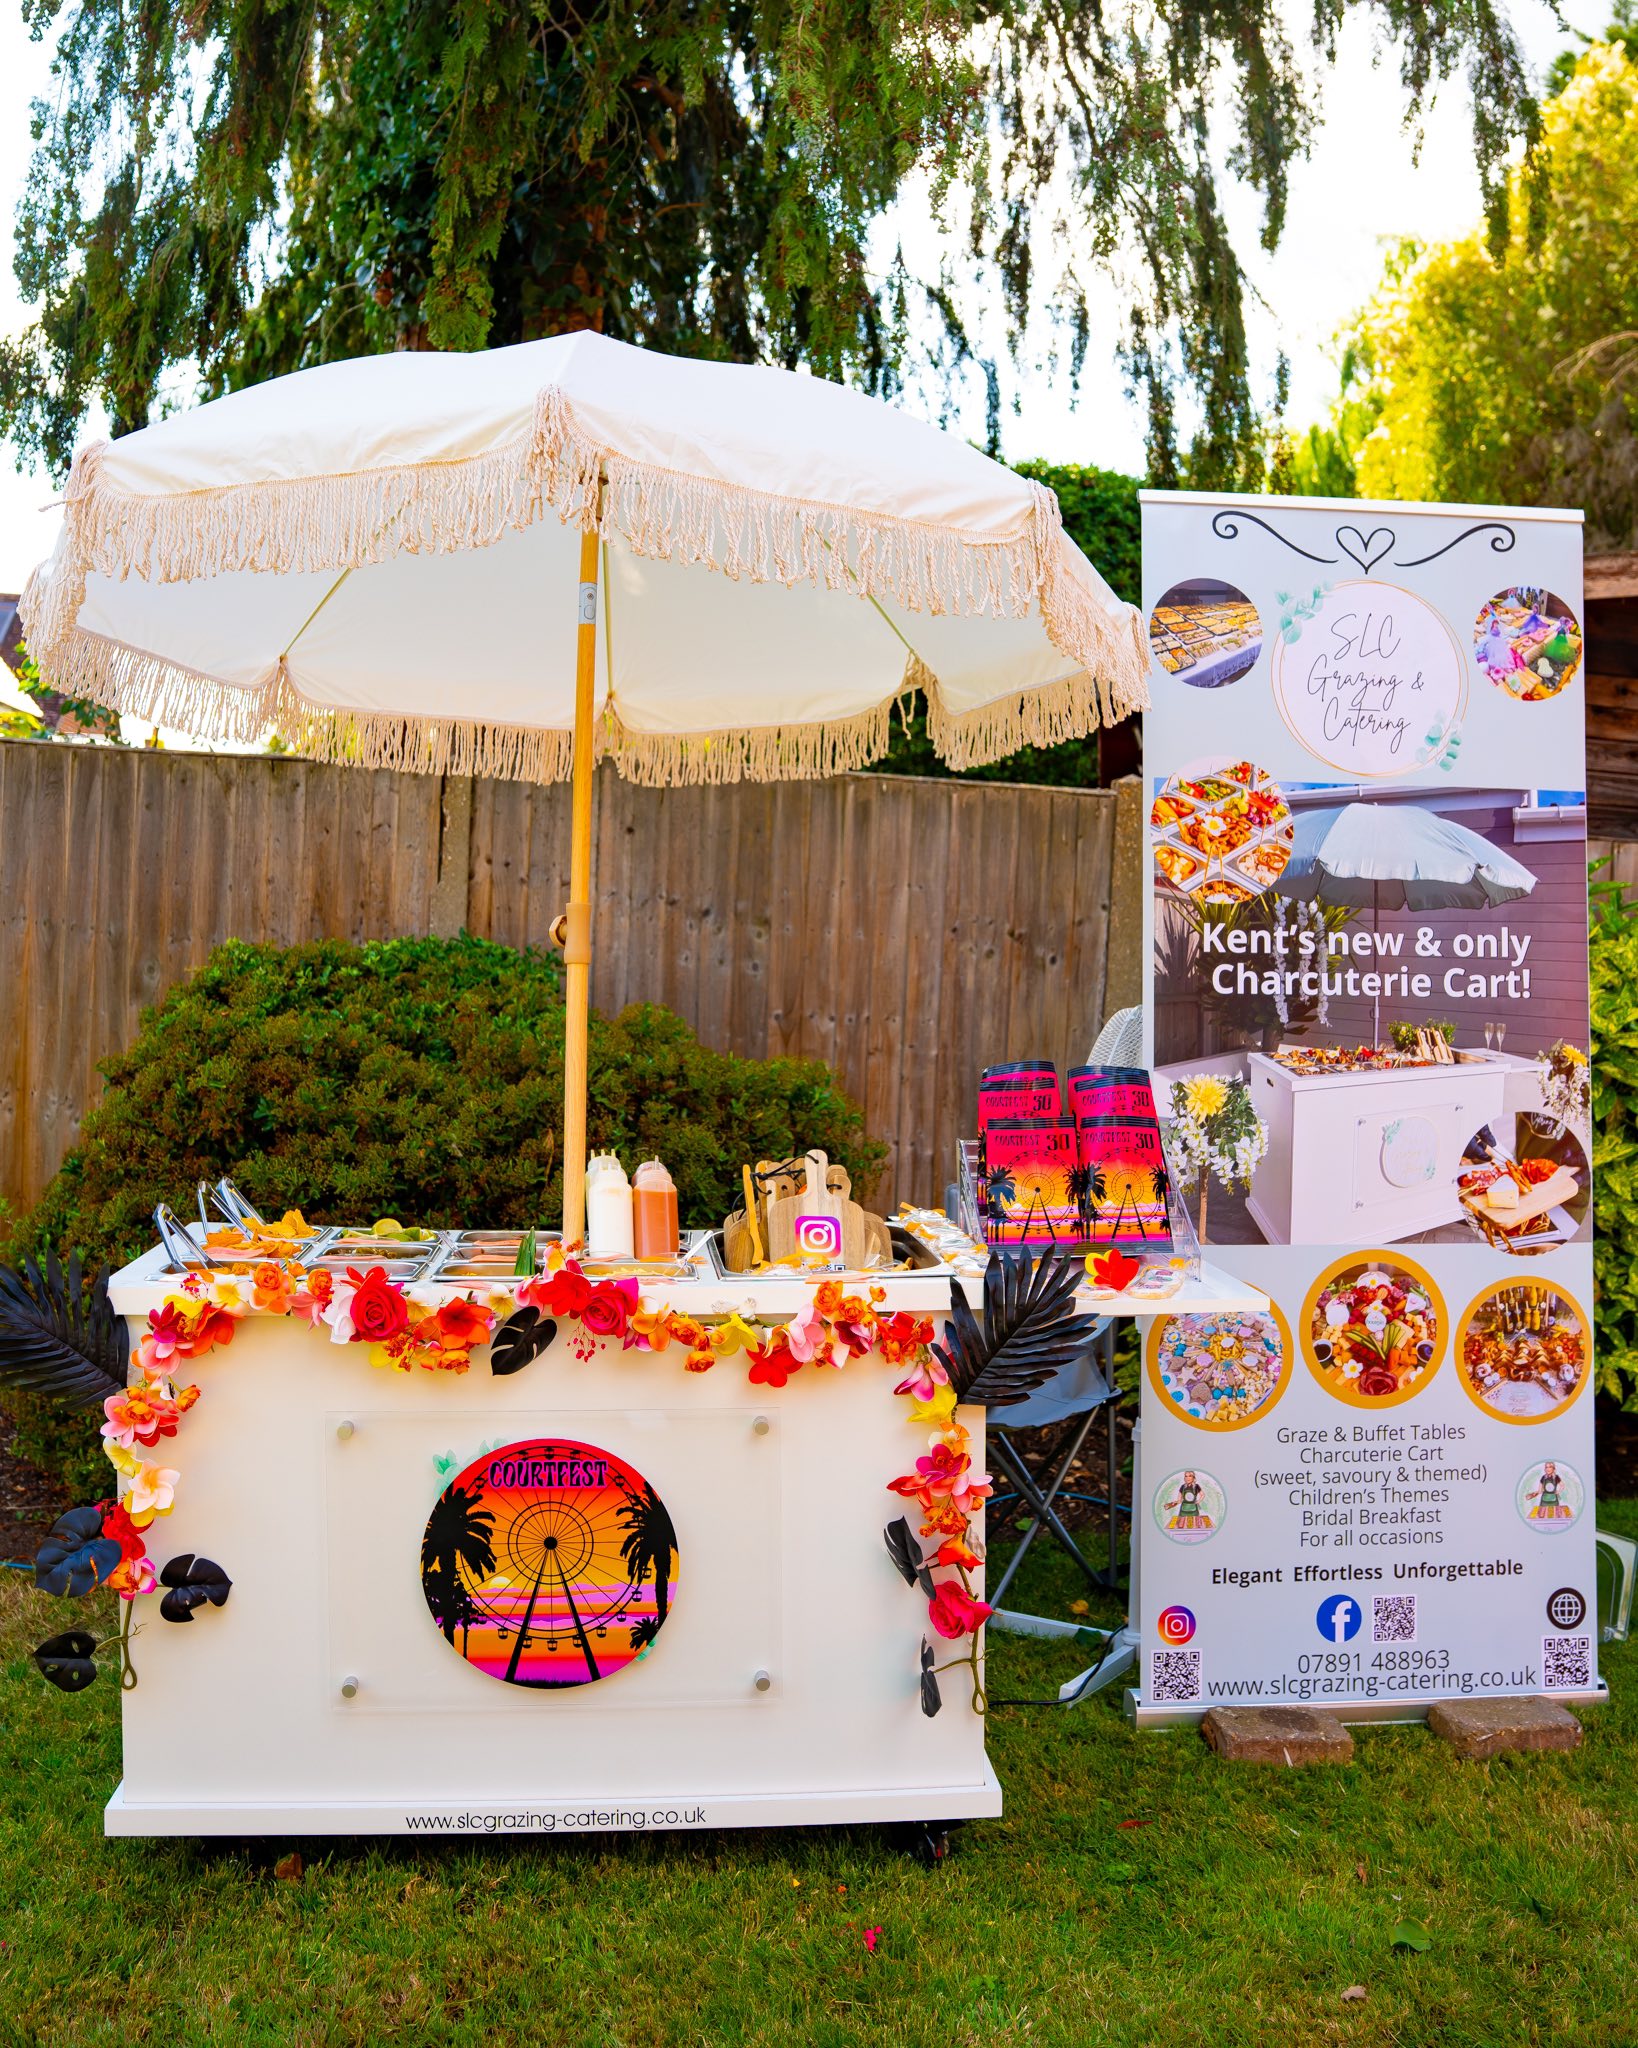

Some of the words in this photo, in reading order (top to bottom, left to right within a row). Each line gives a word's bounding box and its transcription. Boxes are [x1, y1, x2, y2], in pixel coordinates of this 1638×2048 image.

[1331, 613, 1401, 660] SLC
[1307, 654, 1402, 711] Grazing
[1411, 672, 1424, 692] &
[1324, 697, 1410, 754] Catering
[1329, 929, 1404, 956] new
[1415, 927, 1442, 957] &
[1453, 927, 1531, 967] only
[1212, 964, 1431, 998] Charcuterie
[1443, 968, 1531, 999] Cart!
[1033, 1094, 1051, 1111] 30
[1132, 1091, 1149, 1107] 30
[1047, 1134, 1069, 1150] 30
[1135, 1133, 1153, 1149] 30
[1277, 1427, 1328, 1444] Graze
[1333, 1427, 1347, 1443] &
[1353, 1425, 1405, 1442] Buffet
[1410, 1424, 1466, 1441] Tables
[1300, 1447, 1401, 1464] Charcuterie
[1408, 1446, 1443, 1461] Cart
[489, 1460, 608, 1488] COURTFEST
[1254, 1470, 1317, 1488] (sweet,
[1323, 1471, 1391, 1488] savoury
[1397, 1466, 1409, 1483] &
[1415, 1464, 1487, 1483] themed)
[1381, 1486, 1449, 1503] Themes
[1303, 1509, 1353, 1527] Bridal
[1360, 1508, 1441, 1525] Breakfast
[1300, 1531, 1329, 1548] For
[1334, 1529, 1352, 1546] all
[1358, 1529, 1443, 1546] occasions
[1212, 1567, 1282, 1587] Elegant
[1294, 1564, 1382, 1582] Effortless
[1394, 1560, 1523, 1582] Unforgettable
[1298, 1653, 1361, 1674] 07891
[1371, 1649, 1450, 1671] 488963
[1209, 1666, 1536, 1699] www.slcgrazing-catering.co.uk
[406, 1808, 706, 1832] www.slcgrazing-catering.co.uk
